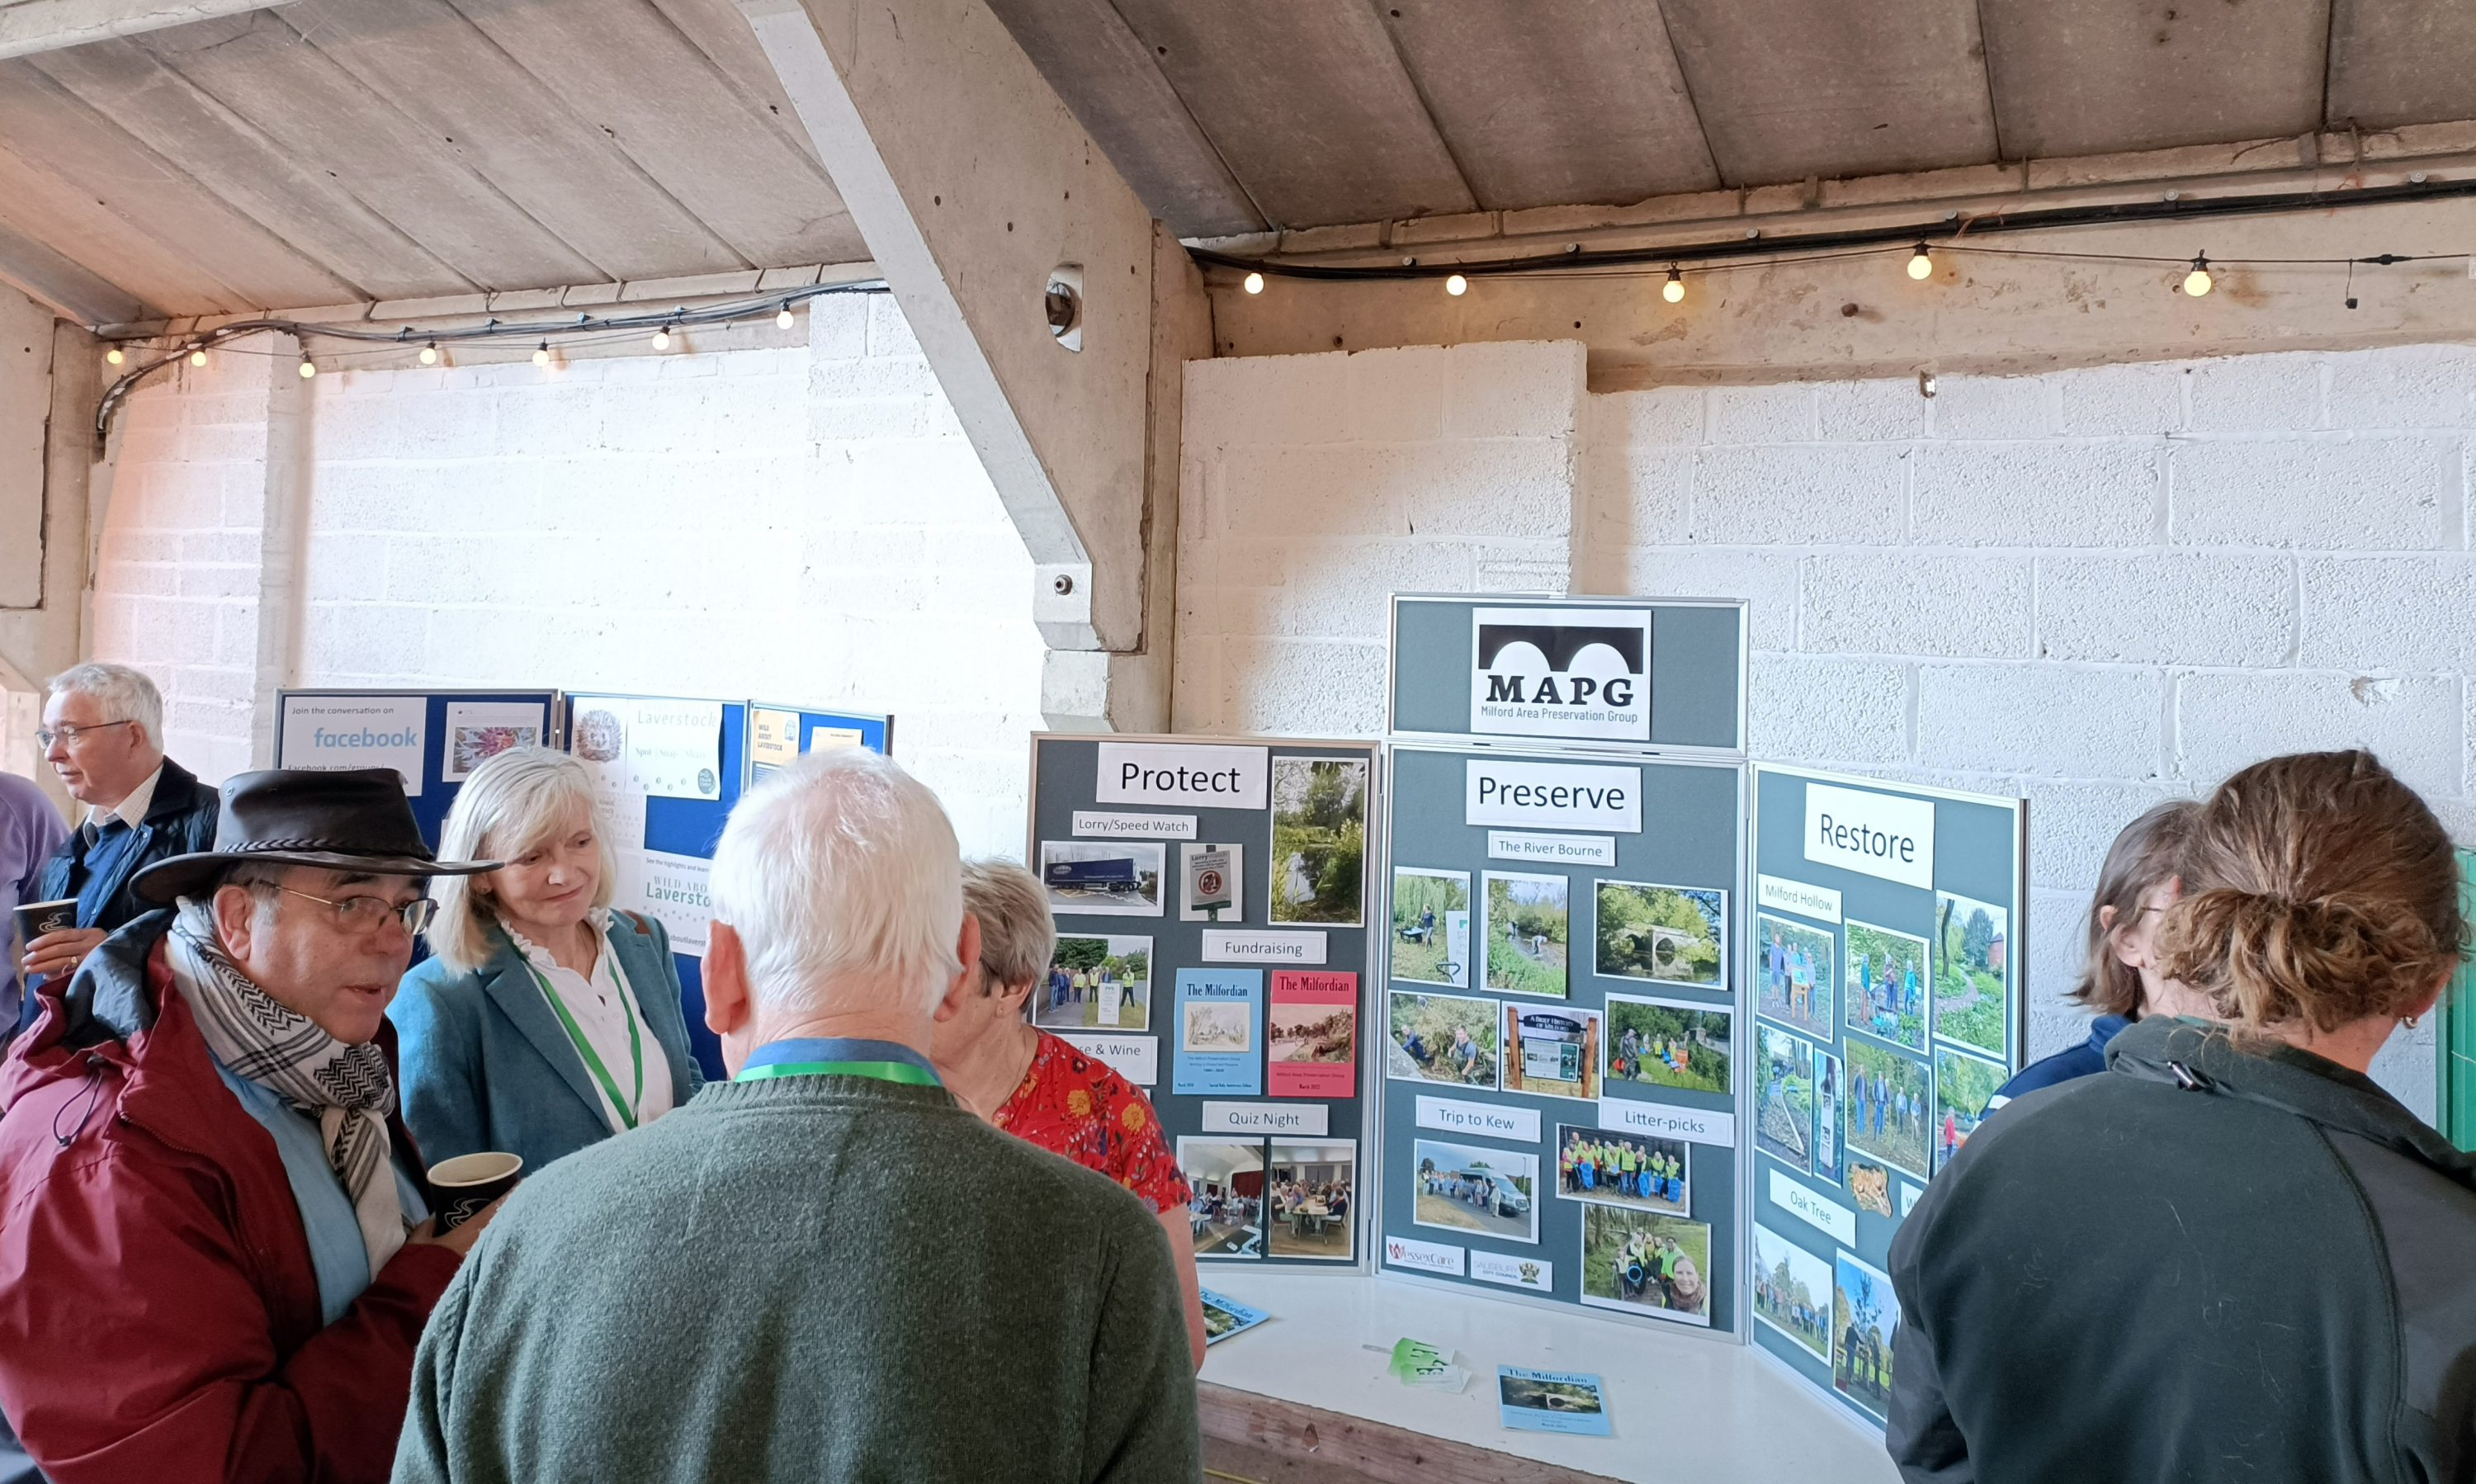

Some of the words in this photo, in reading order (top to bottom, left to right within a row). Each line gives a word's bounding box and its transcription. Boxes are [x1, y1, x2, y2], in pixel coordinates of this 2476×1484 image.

[1486, 674, 1634, 707] MAPG
[638, 710, 717, 727] Laverstock
[1481, 706, 1514, 718] Milford
[1516, 707, 1539, 719] Area
[1542, 708, 1605, 721] Preservation
[1608, 711, 1638, 725] Group
[314, 726, 418, 748] facebook
[1122, 763, 1241, 793] Protect
[1480, 777, 1625, 811] Preserve
[1079, 818, 1150, 833] Lorry/Speed
[1153, 820, 1189, 833] Watch
[1820, 813, 1914, 863] Restore
[1499, 841, 1520, 853] The
[1524, 843, 1555, 855] River
[1557, 844, 1603, 858] Bourne
[654, 875, 681, 889] WILD
[685, 881, 708, 893] ABO
[646, 881, 711, 908] Laversto
[1765, 884, 1798, 904] Milford
[1800, 892, 1833, 912] Hollow
[1225, 941, 1303, 957] Fundraising
[1186, 984, 1203, 996] The
[1204, 984, 1248, 997] Milfordian
[1279, 976, 1297, 990] The
[1299, 977, 1349, 992] Milfordian
[1095, 1044, 1105, 1055] &
[1109, 1044, 1141, 1056] Wine
[1228, 1112, 1259, 1125] Quiz
[1264, 1113, 1300, 1128] Night
[1439, 1108, 1464, 1128] Trip
[1469, 1113, 1482, 1126] to
[1486, 1114, 1515, 1130] Kew
[1624, 1110, 1705, 1134] Litter-picks
[1790, 1190, 1808, 1211] Oak
[1811, 1201, 1831, 1225] Tree
[1473, 1260, 1519, 1274] SALISBURY
[1496, 1271, 1519, 1279] COUNCIL
[1508, 1368, 1529, 1378] The
[1531, 1372, 1588, 1384] Milfordian
